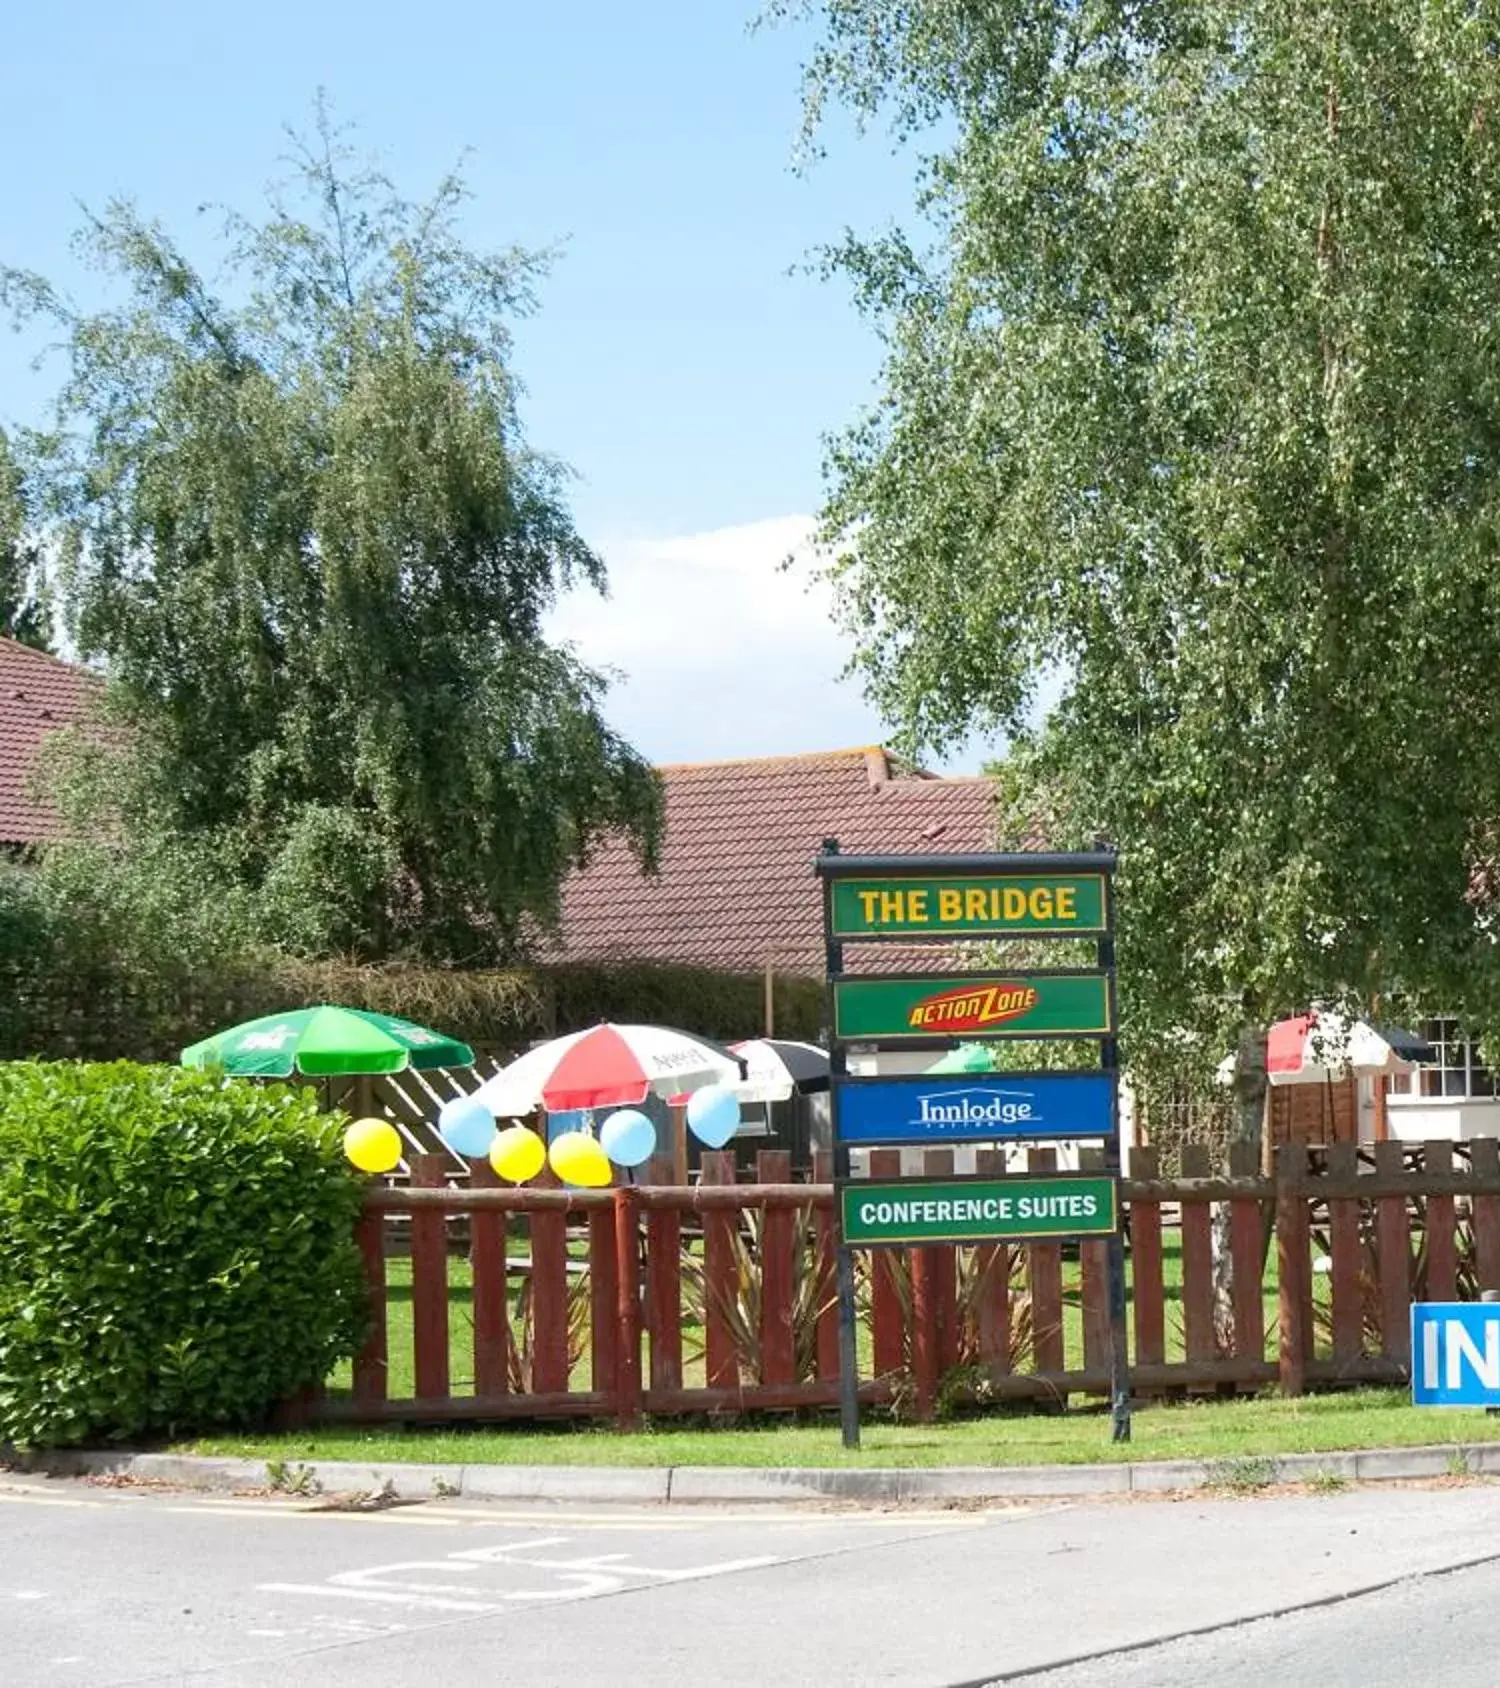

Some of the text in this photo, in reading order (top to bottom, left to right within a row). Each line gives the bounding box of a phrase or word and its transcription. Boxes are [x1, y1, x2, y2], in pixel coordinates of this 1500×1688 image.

[858, 887, 1077, 924] THE BRIDGE
[920, 1097, 1031, 1123] Innlodge
[860, 1195, 1097, 1224] CONFERENCE SUITES
[1423, 1319, 1500, 1389] IN
